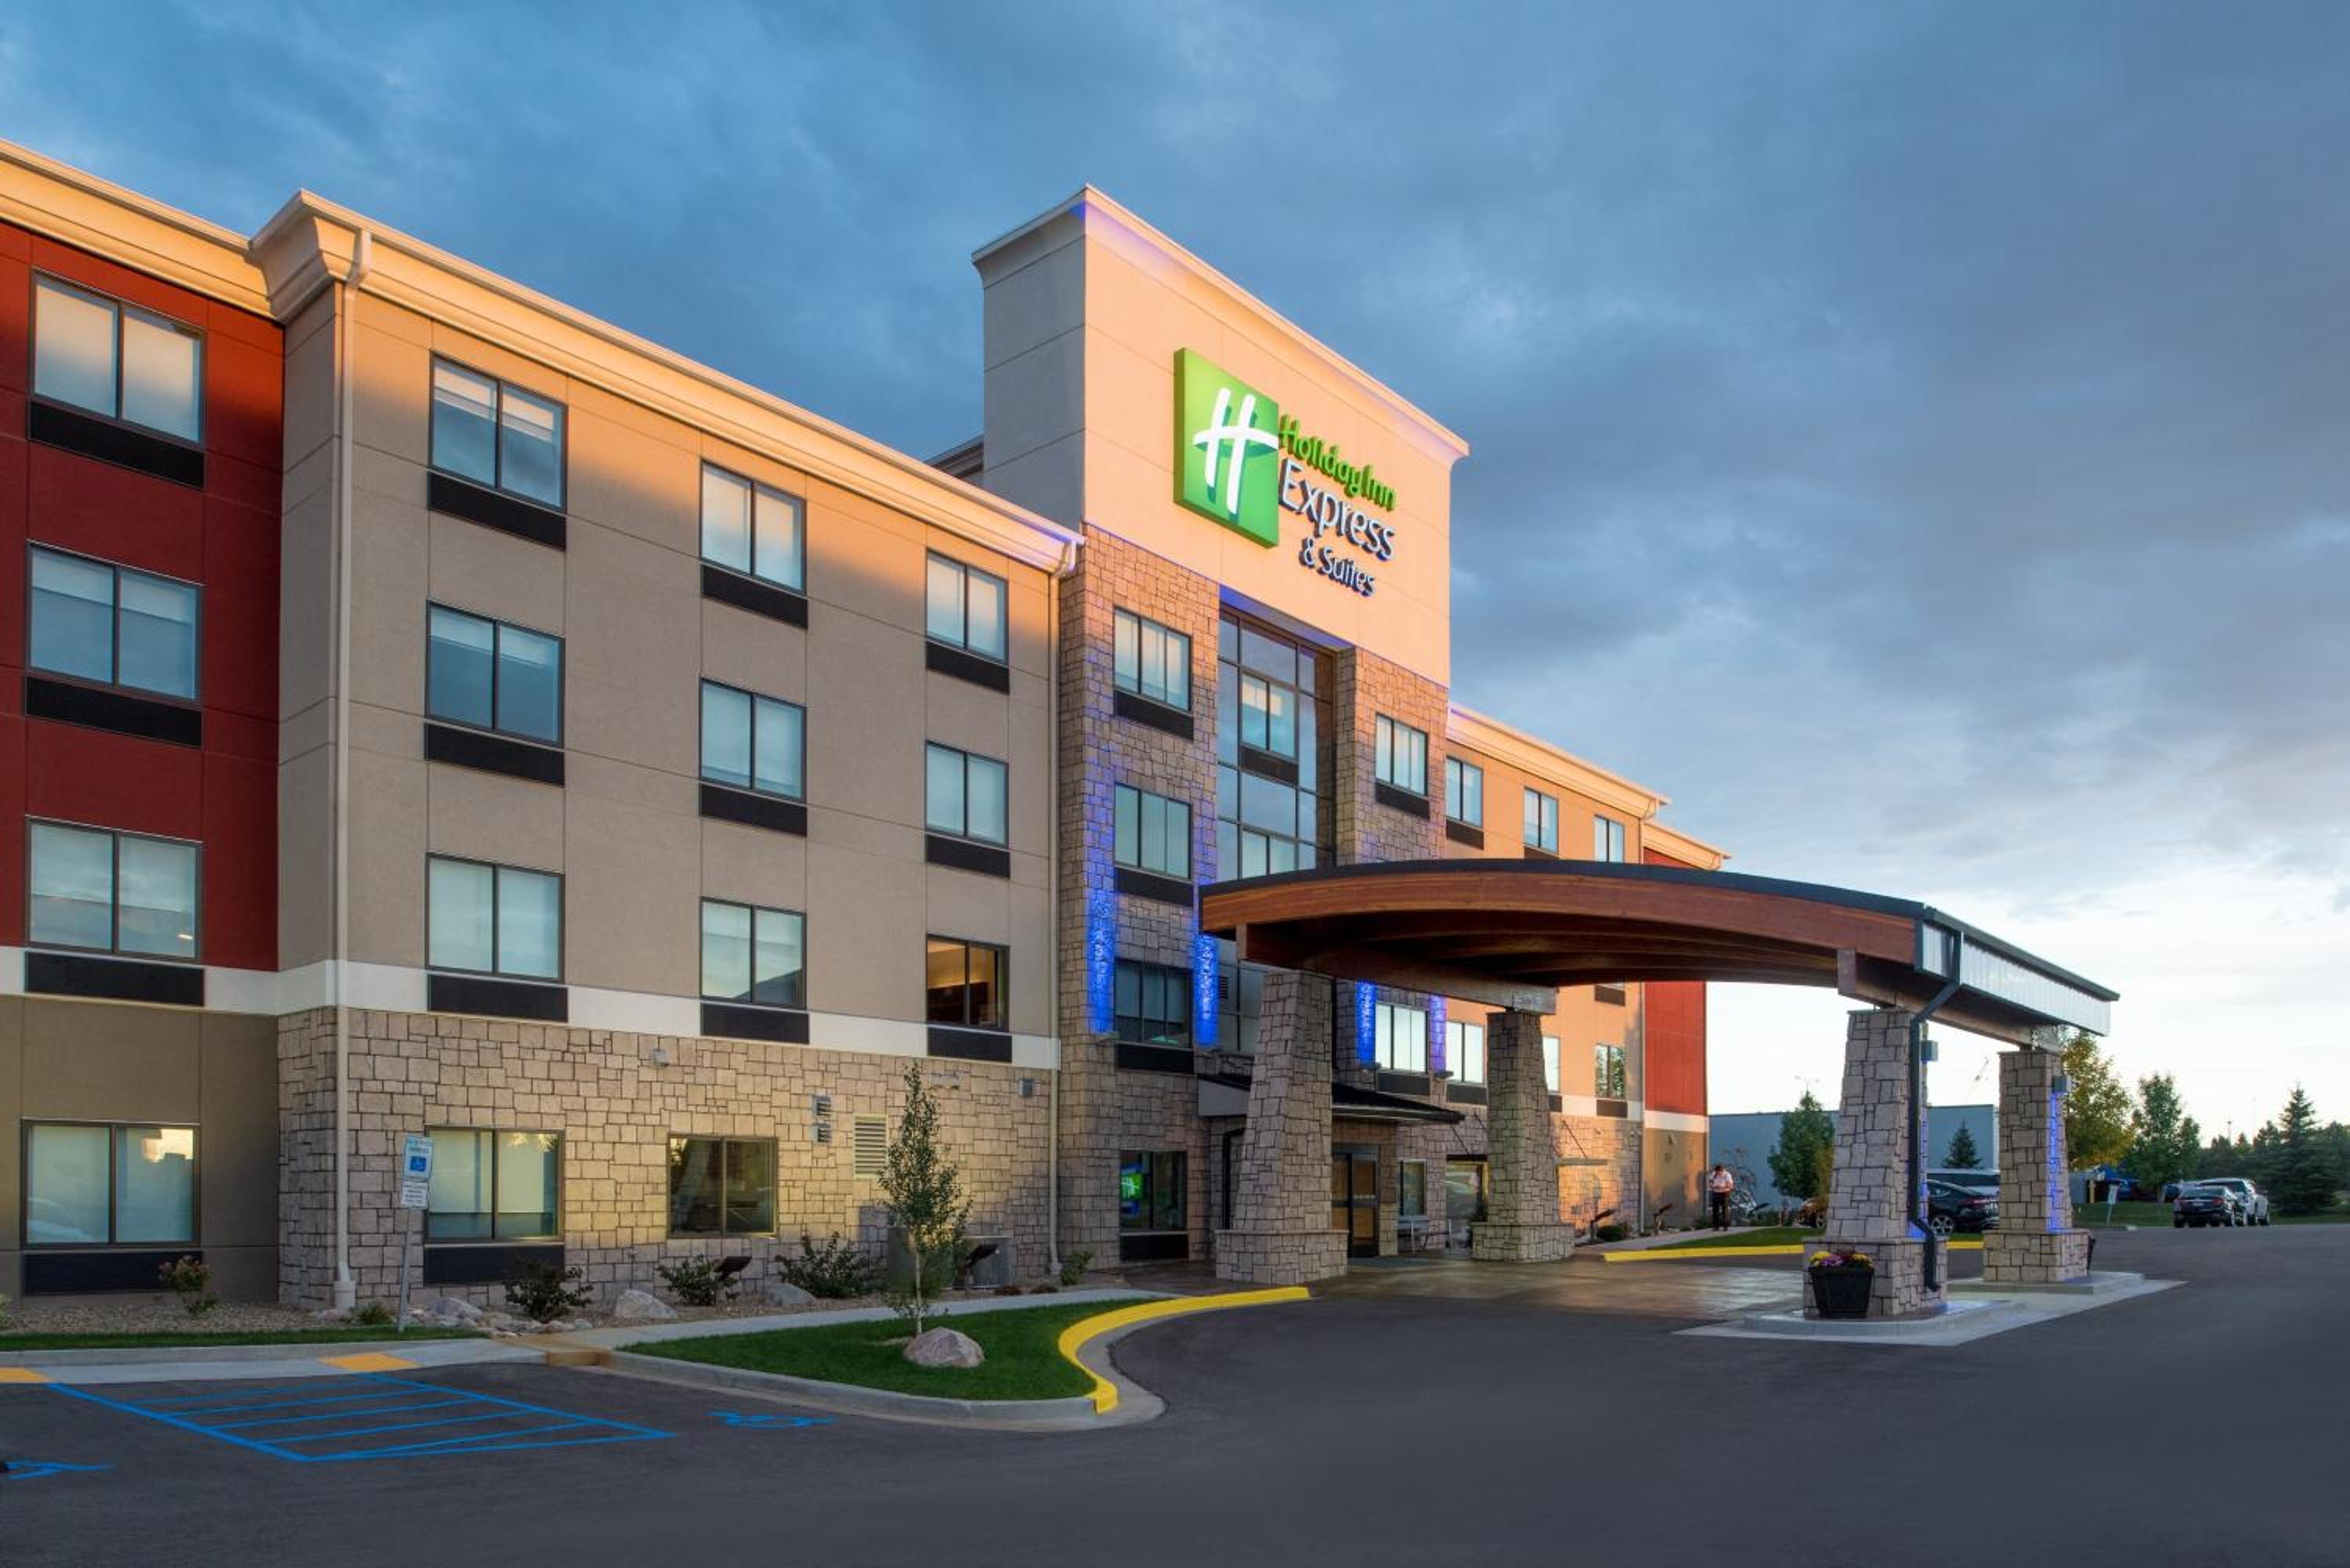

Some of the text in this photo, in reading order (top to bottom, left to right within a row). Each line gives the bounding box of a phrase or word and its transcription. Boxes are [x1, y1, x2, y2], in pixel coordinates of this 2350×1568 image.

[1278, 414, 1395, 511] Holiday Inn
[1278, 458, 1395, 561] Express
[1299, 537, 1375, 597] & Suites
